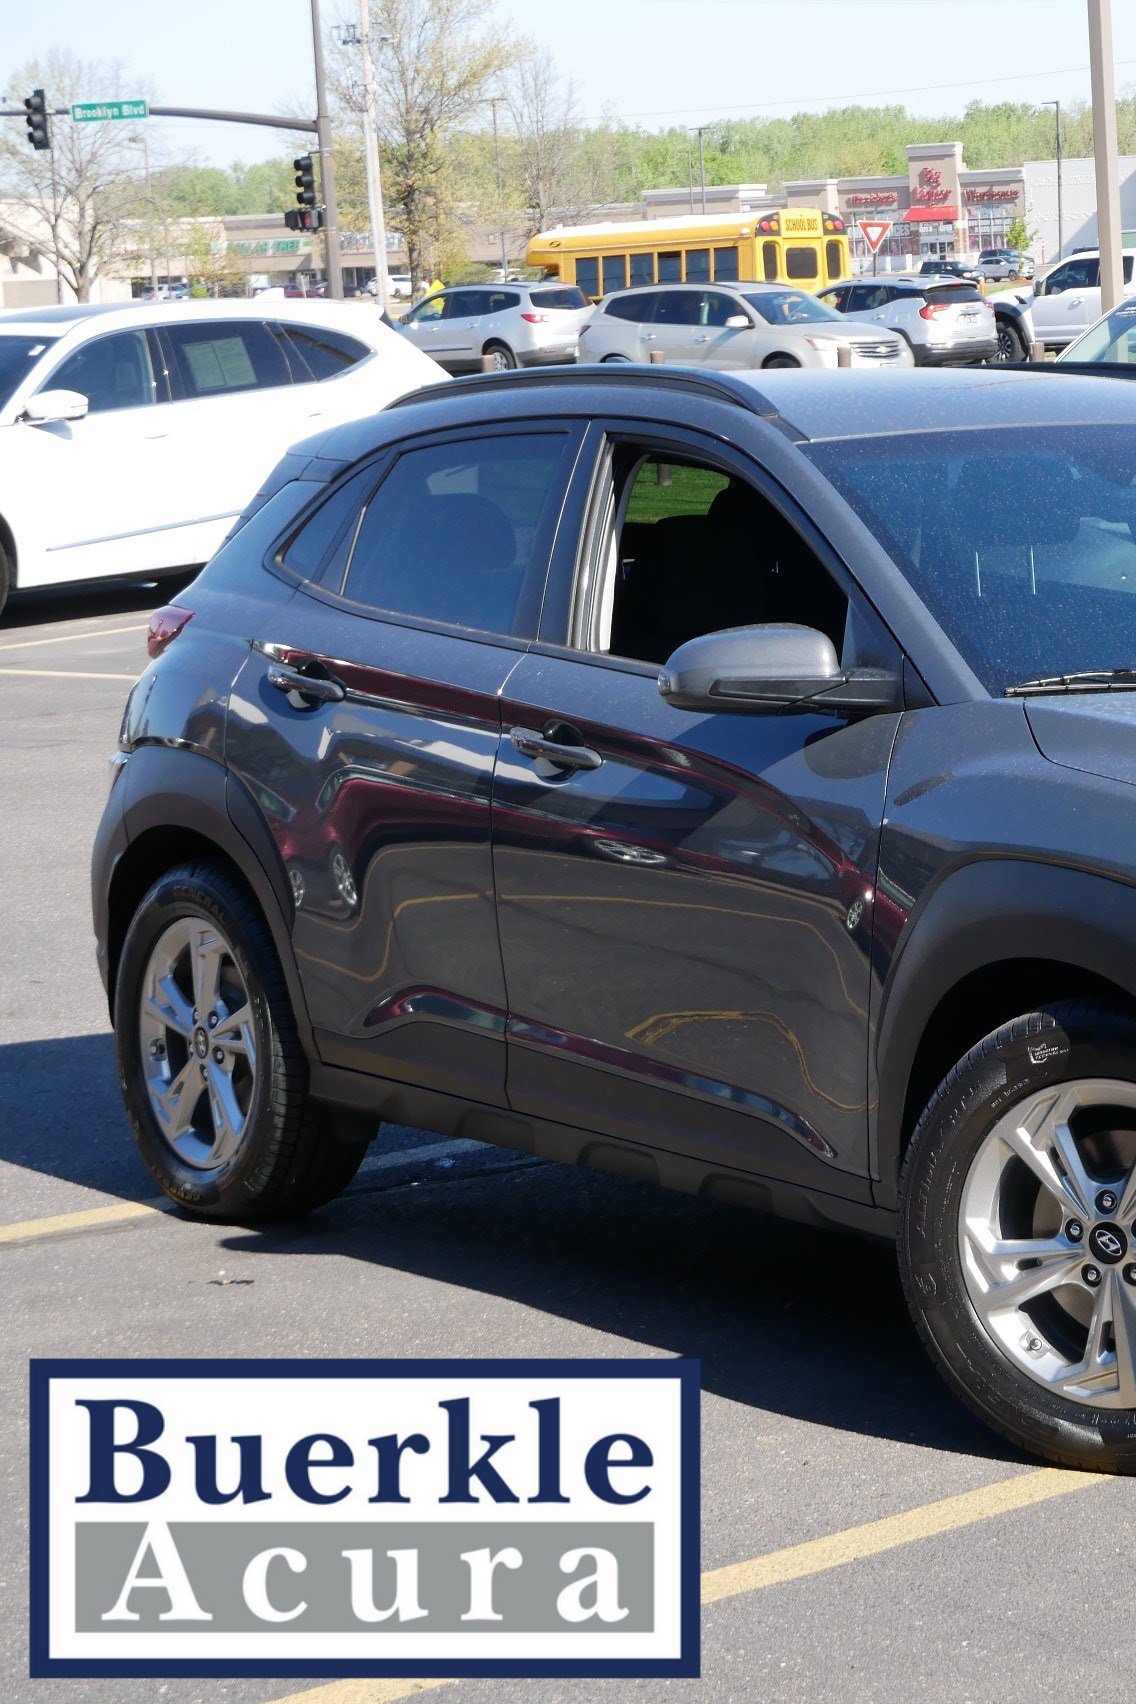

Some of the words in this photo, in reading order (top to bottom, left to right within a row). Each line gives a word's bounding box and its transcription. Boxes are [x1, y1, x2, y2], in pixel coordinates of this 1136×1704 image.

[74, 106, 120, 120] Brooklyn
[121, 103, 145, 116] Blvd
[785, 219, 806, 231] SCHOOL
[807, 218, 819, 231] BUS
[273, 239, 301, 251] TREE
